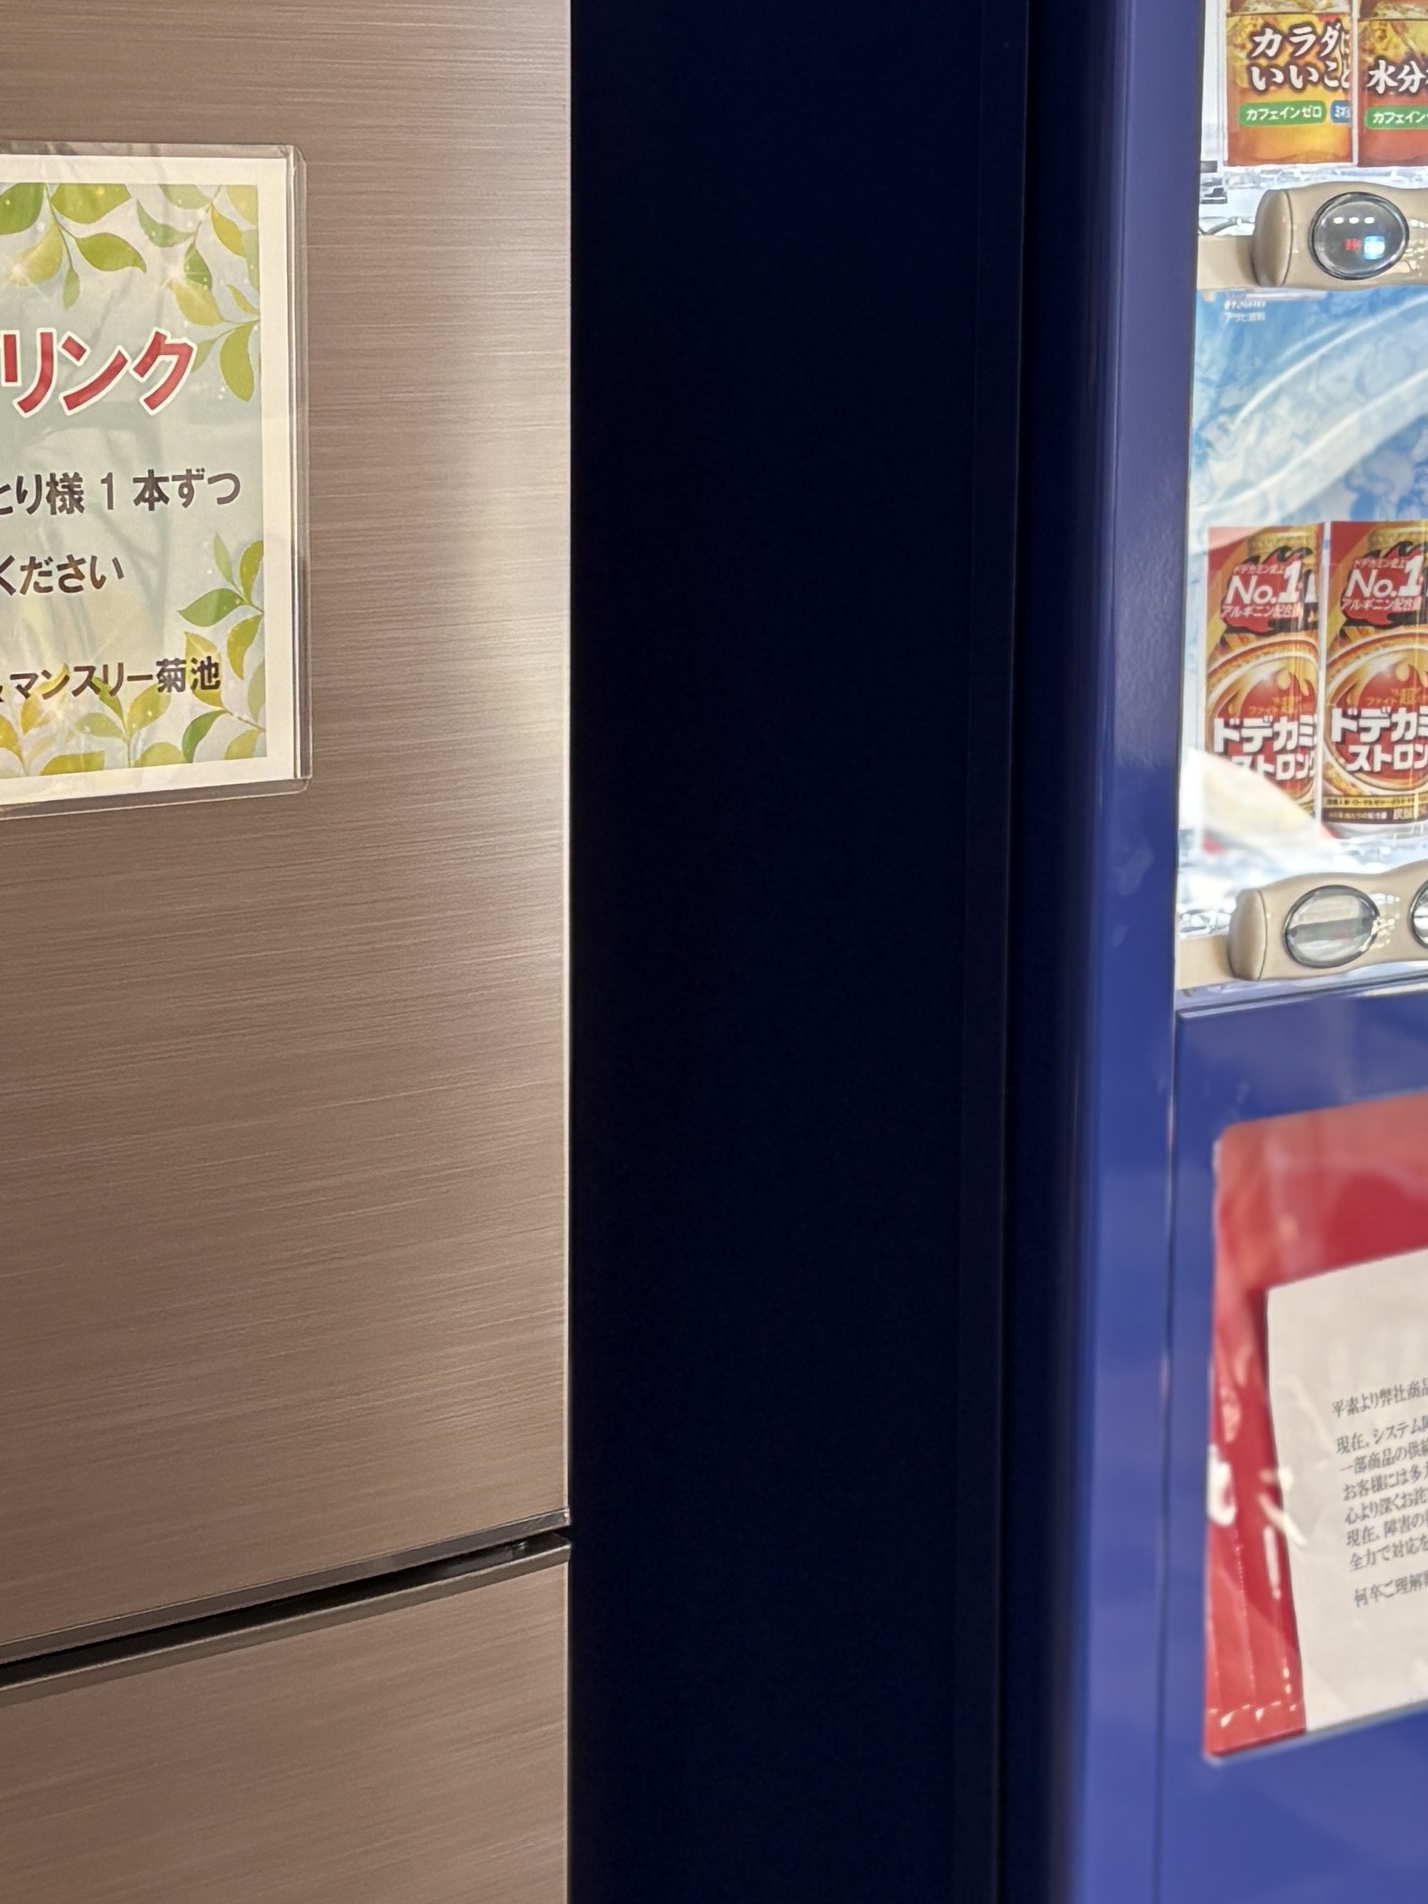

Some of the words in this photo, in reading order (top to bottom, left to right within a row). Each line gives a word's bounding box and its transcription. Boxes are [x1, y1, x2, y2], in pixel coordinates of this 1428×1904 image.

[1246, 105, 1322, 121] カフェインゼロ
[1213, 714, 1317, 753] ドデカミ
